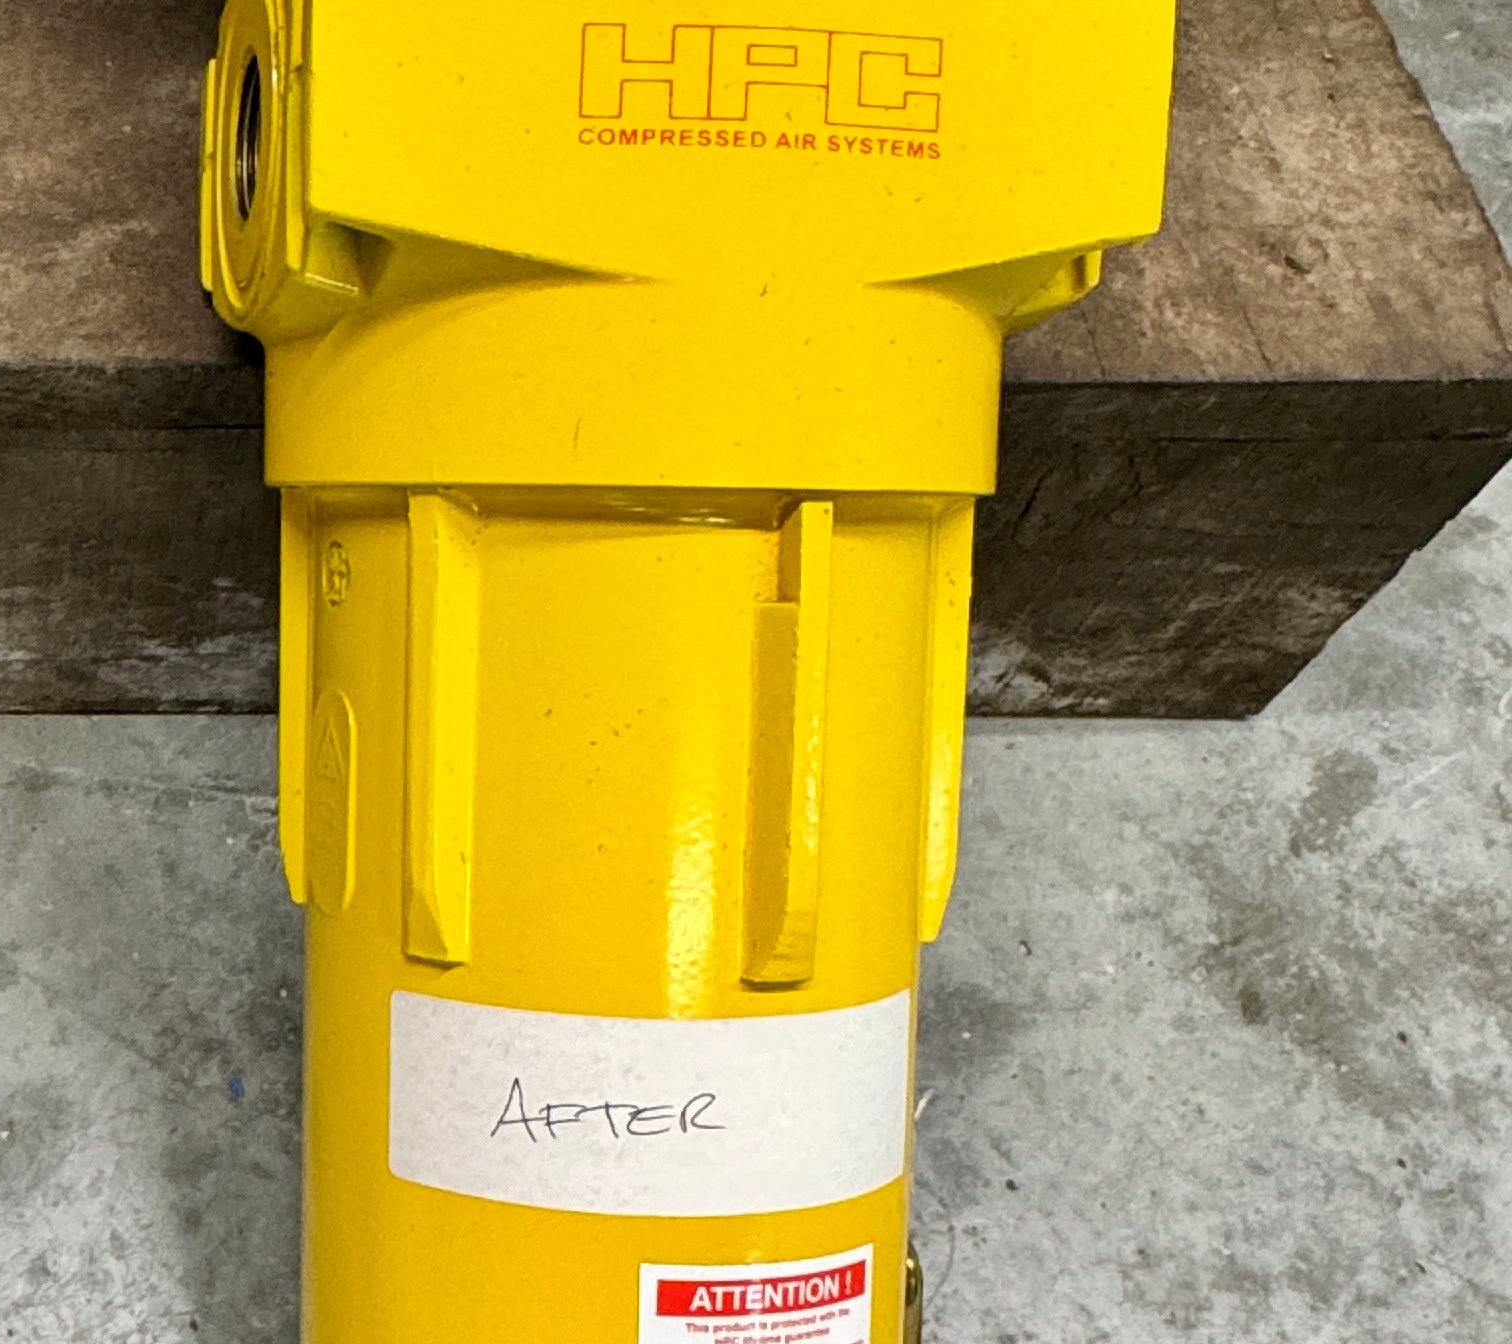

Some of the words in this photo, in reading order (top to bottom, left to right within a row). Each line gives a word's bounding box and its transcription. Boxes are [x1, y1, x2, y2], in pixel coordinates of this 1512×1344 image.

[579, 22, 943, 133] HPC
[578, 127, 767, 149] COMPRESSED
[775, 132, 817, 151] AIR
[827, 134, 941, 160] SYSTEMS
[490, 1076, 727, 1143] AFTER
[688, 1272, 840, 1312] ATTENTION
